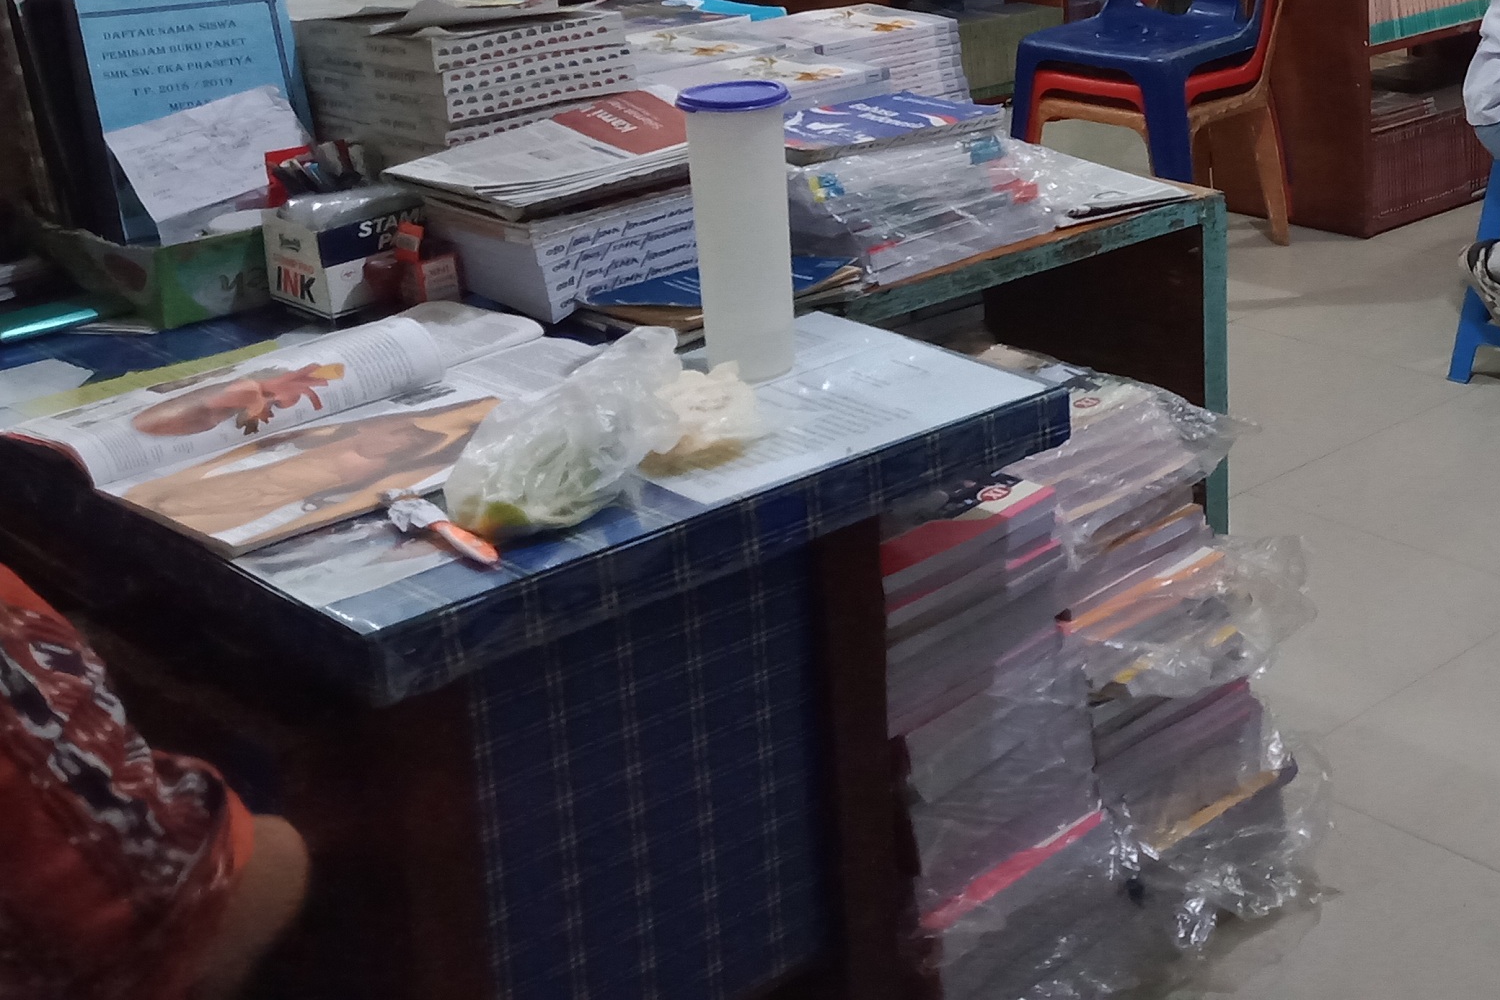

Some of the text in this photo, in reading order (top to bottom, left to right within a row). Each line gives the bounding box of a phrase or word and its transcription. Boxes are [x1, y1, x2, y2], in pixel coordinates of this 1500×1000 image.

[103, 19, 237, 40] DAFTAR NAMA SISWA
[102, 38, 246, 61] PEMINJAM BUKU PAKET
[103, 67, 129, 80] SMK
[158, 63, 183, 74] EKA
[188, 55, 252, 70] PRASETYA
[277, 265, 316, 304] INK
